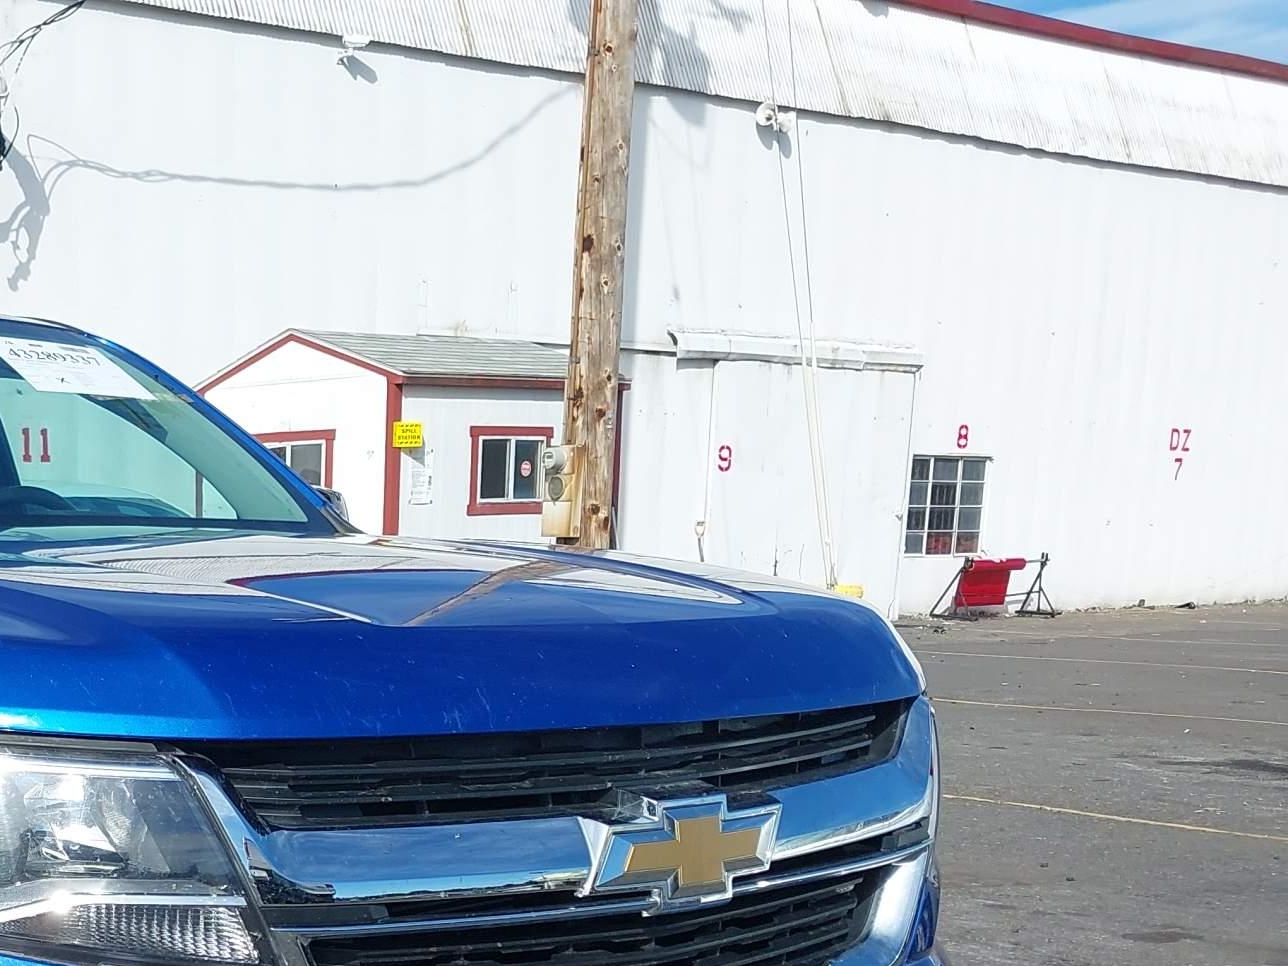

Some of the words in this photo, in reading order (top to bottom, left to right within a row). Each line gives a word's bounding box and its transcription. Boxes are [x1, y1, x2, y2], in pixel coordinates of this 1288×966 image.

[8, 347, 101, 366] 43289337
[21, 427, 51, 463] 11
[956, 424, 969, 449] 8
[1169, 428, 1192, 452] DZ
[717, 445, 732, 472] 9
[1174, 458, 1183, 481] 7
